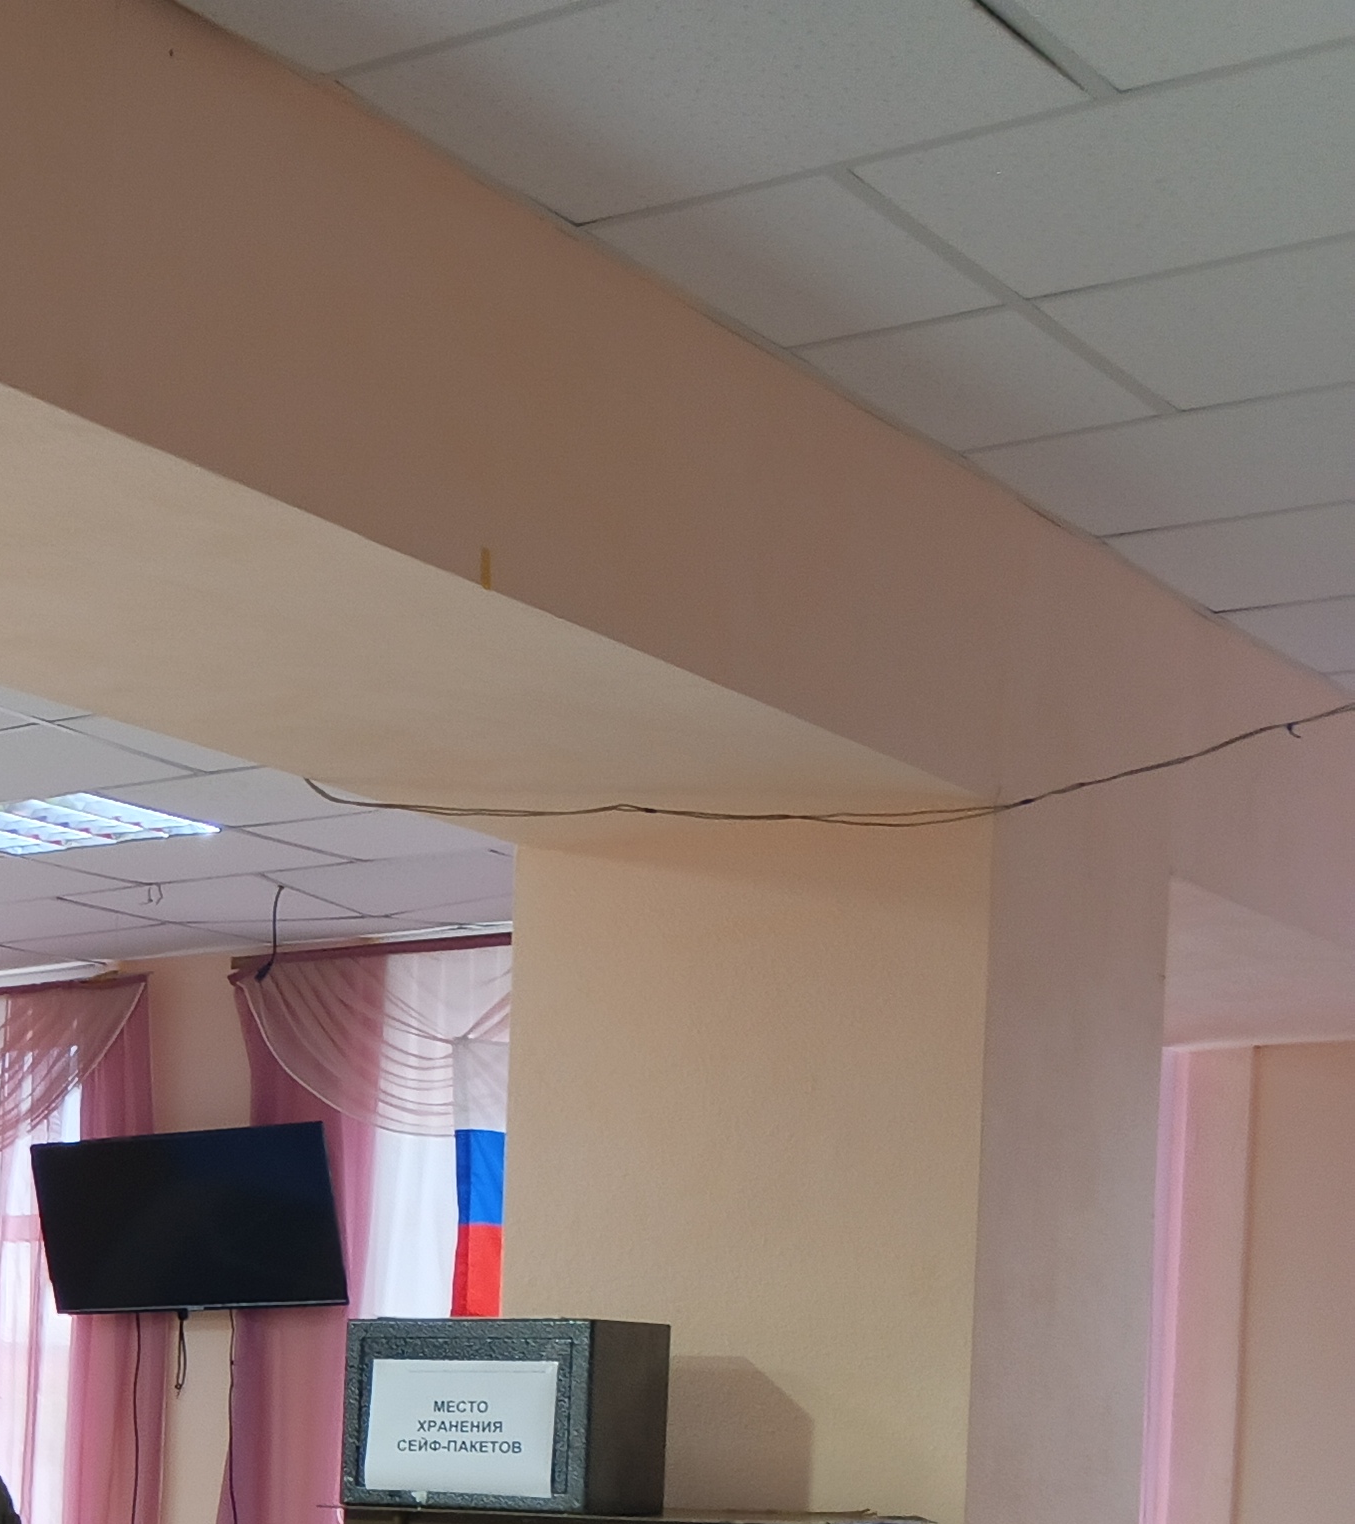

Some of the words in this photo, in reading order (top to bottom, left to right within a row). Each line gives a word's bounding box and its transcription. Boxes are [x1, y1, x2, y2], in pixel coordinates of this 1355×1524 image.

[433, 1400, 488, 1413] МЕСТО
[417, 1420, 503, 1433] ХРАНЕНИЯ
[397, 1437, 522, 1454] СЕЙФ-ПАКЕТОВ
